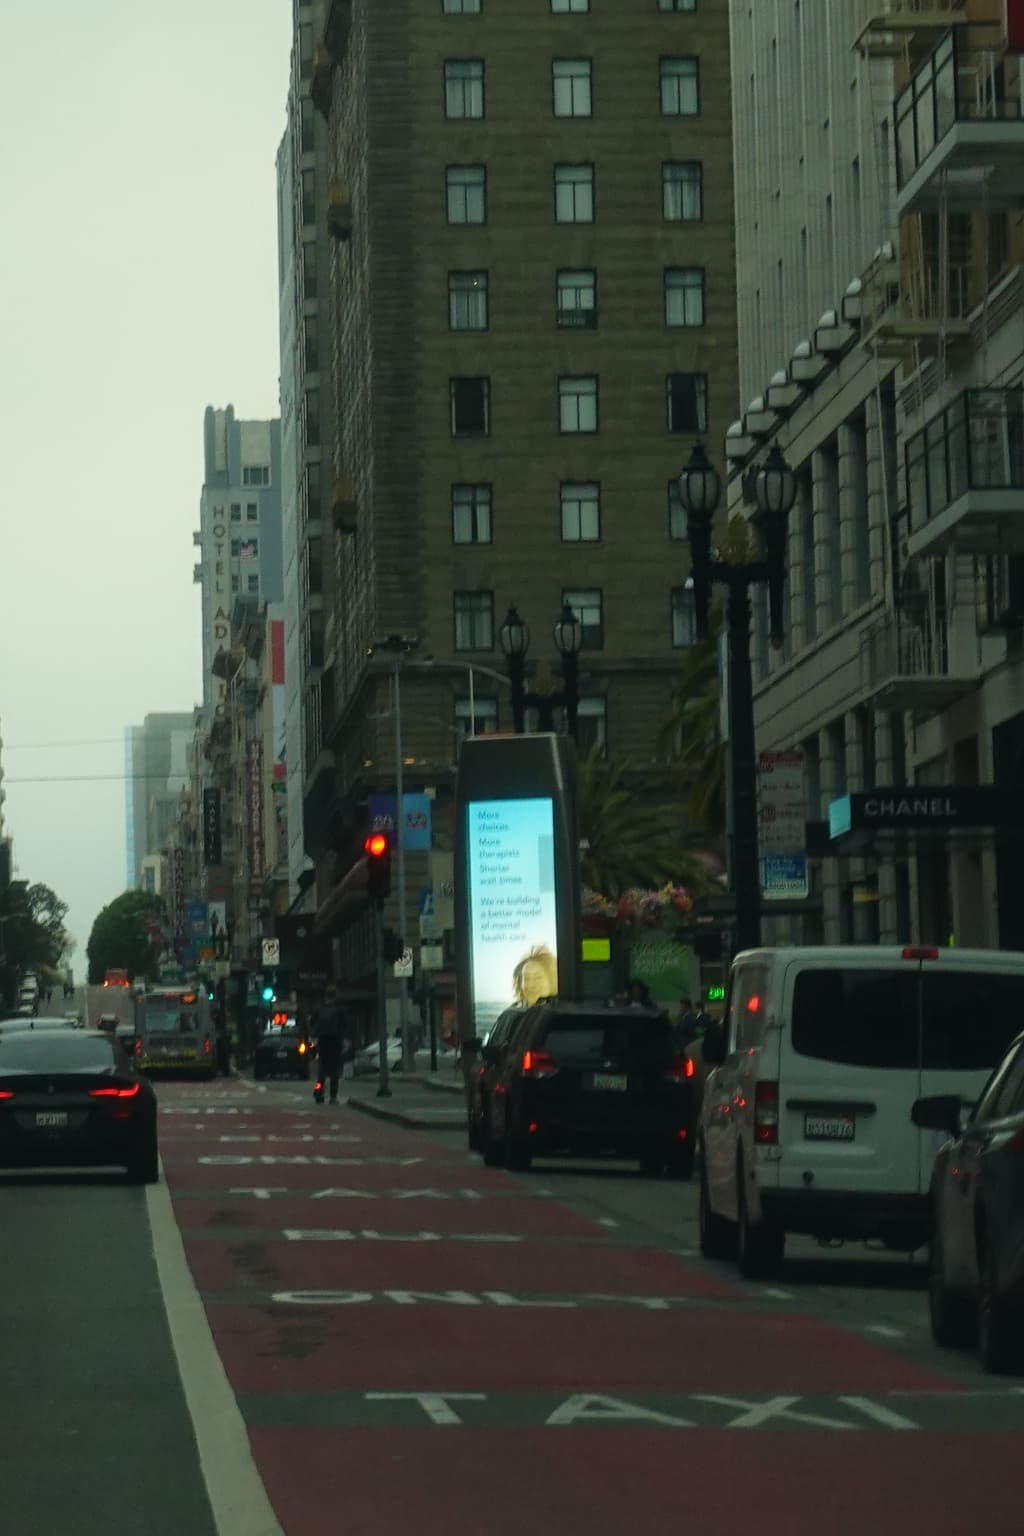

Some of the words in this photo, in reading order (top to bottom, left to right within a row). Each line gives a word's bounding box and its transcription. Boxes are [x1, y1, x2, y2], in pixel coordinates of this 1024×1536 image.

[864, 798, 958, 817] CHANEL
[478, 811, 500, 820] More
[479, 838, 500, 847] More
[480, 864, 510, 873] Shorter
[481, 897, 505, 907] We're
[507, 895, 541, 907] building
[488, 908, 513, 918] better
[516, 908, 543, 917] model
[229, 1186, 484, 1200] TAXI
[283, 1228, 524, 1242] BUS
[271, 1289, 692, 1310] ONLY
[365, 1392, 921, 1430] TAXI
